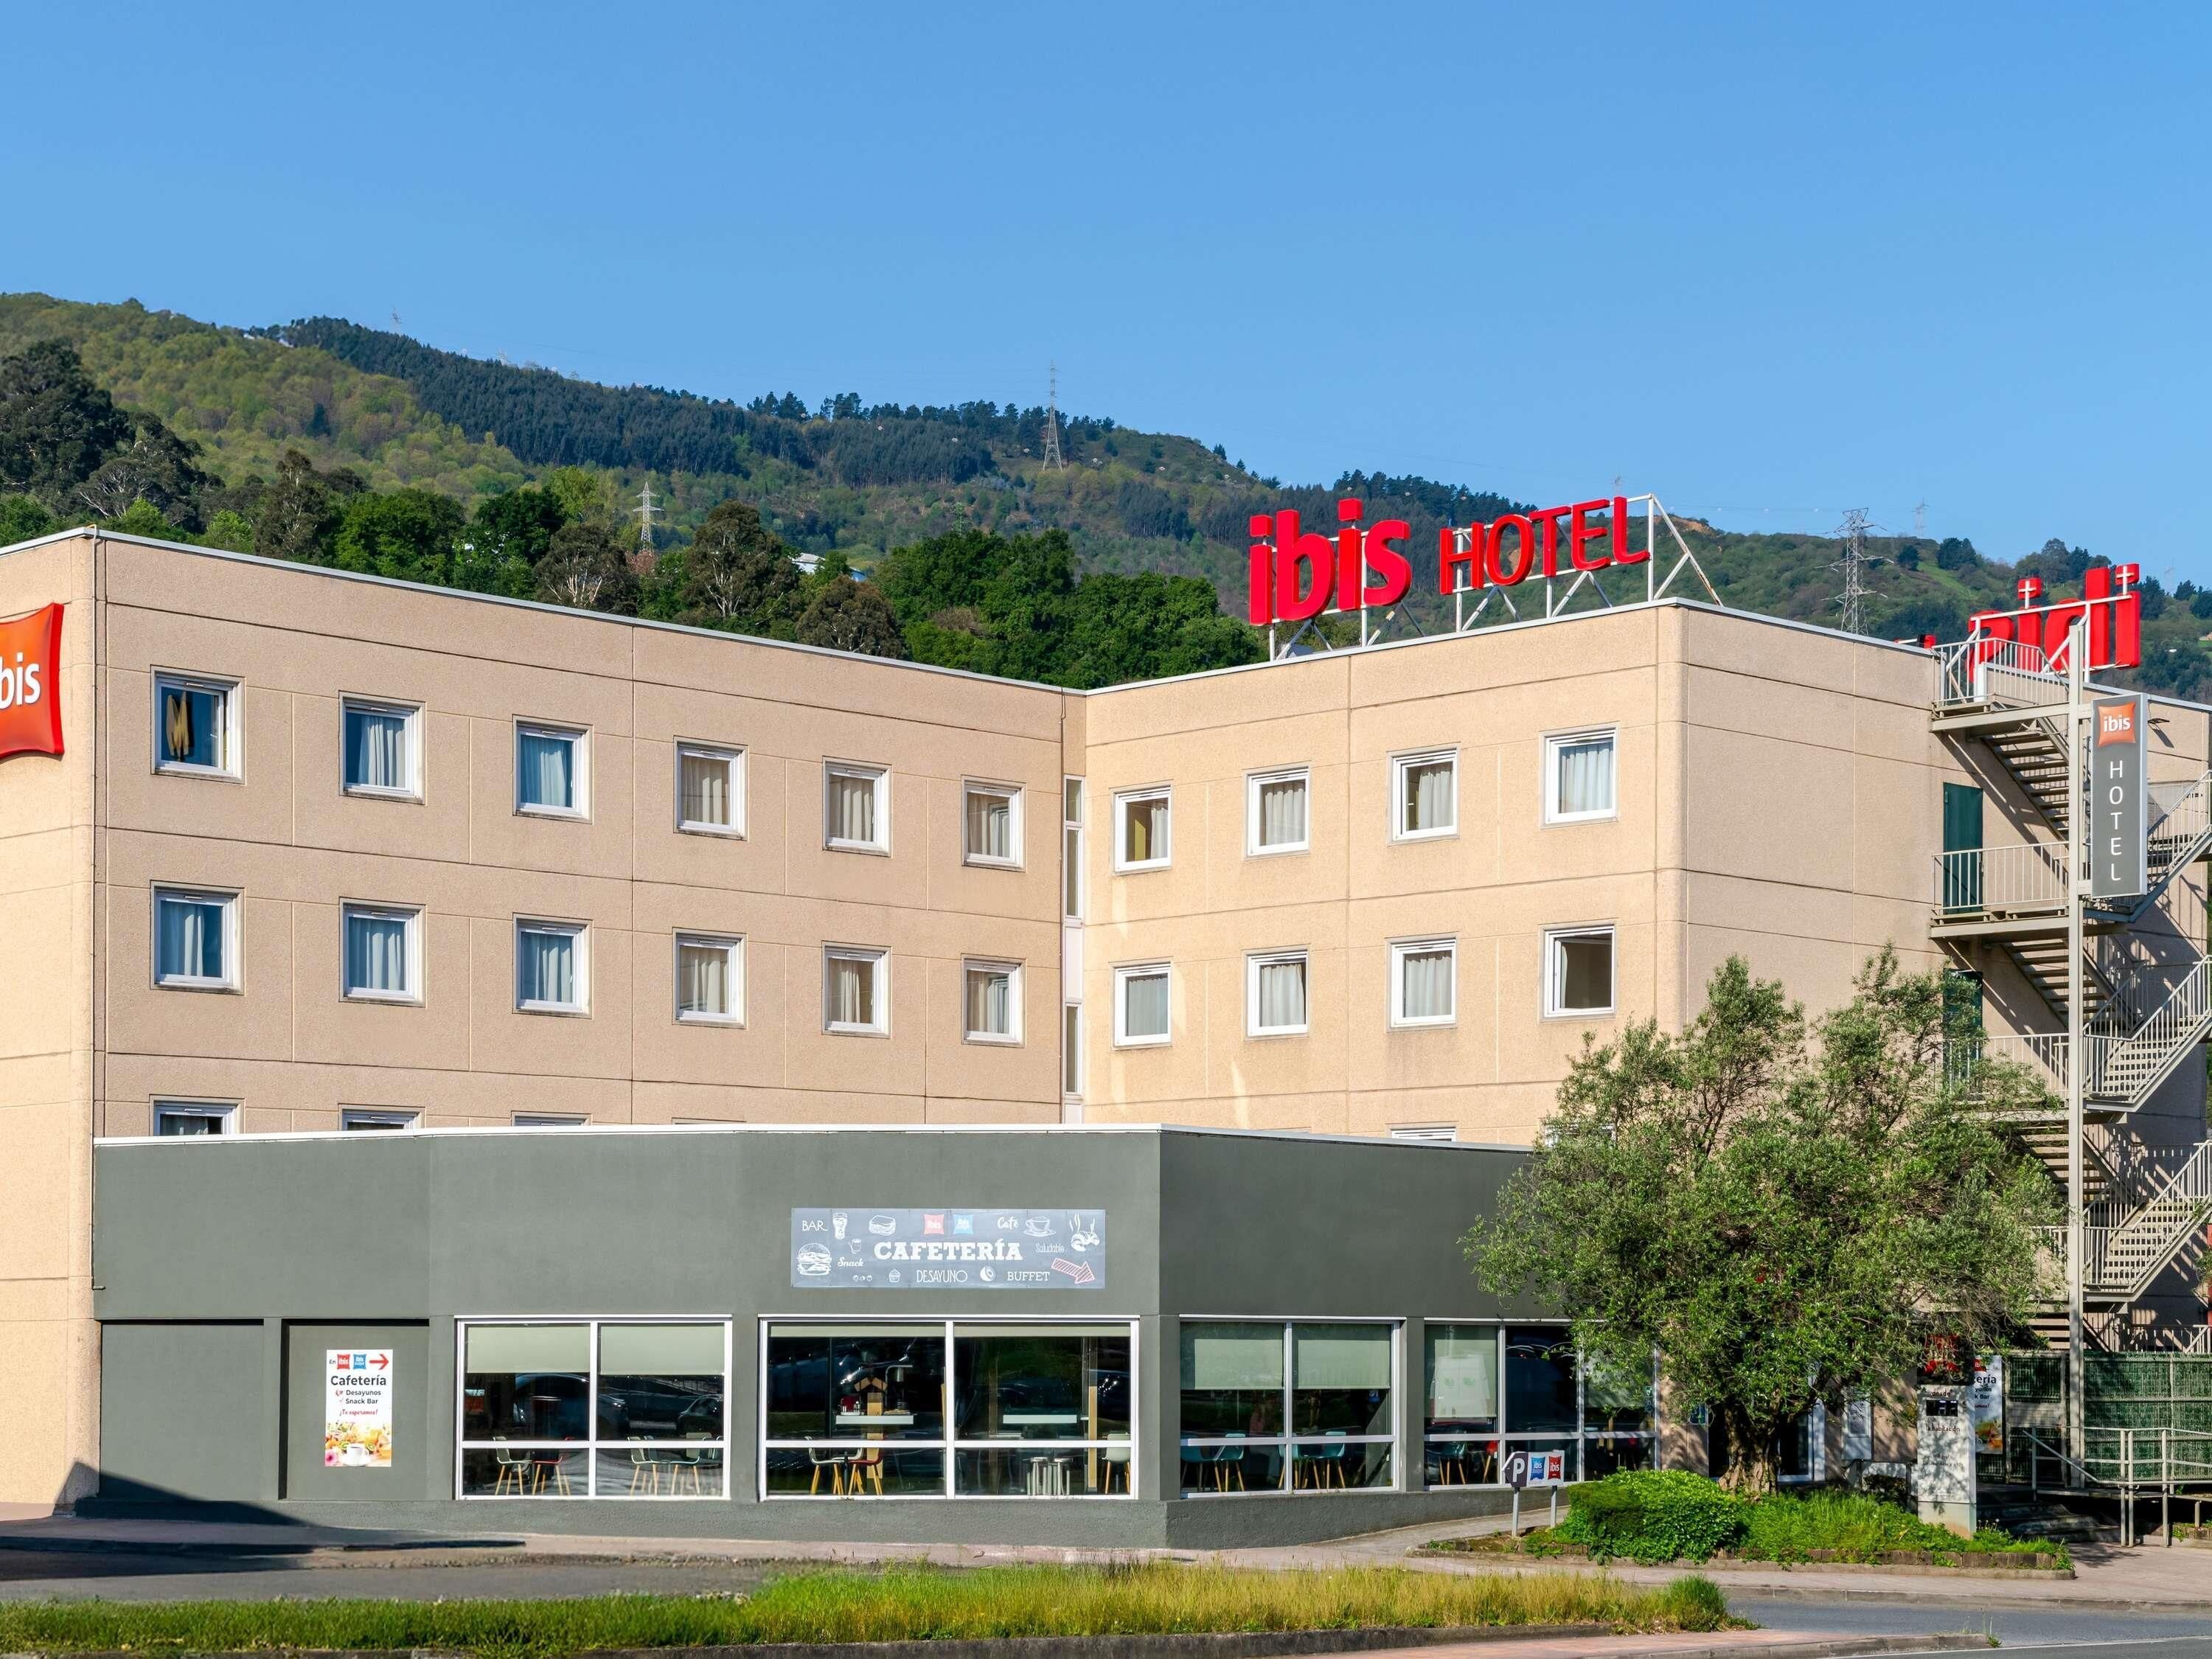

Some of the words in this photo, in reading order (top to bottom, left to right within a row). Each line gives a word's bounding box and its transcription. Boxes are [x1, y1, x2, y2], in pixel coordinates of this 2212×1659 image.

[1250, 498, 1411, 625] ibis
[1439, 496, 1650, 595] HOTEL
[2104, 714, 2131, 732] ibis
[2109, 759, 2124, 882] HOTEL
[801, 1220, 828, 1232] BAR
[997, 1217, 1019, 1230] Café
[874, 1238, 1023, 1261] CAFETERÍA
[1035, 1242, 1065, 1253] Saludable
[838, 1256, 864, 1267] Snack
[917, 1270, 967, 1283] DESAYUNO
[1007, 1270, 1050, 1281] BUFFET
[339, 1357, 349, 1365] ibis
[330, 1374, 387, 1385] Cafetería
[1512, 1458, 1526, 1482] P
[1550, 1461, 1560, 1472] ibis
